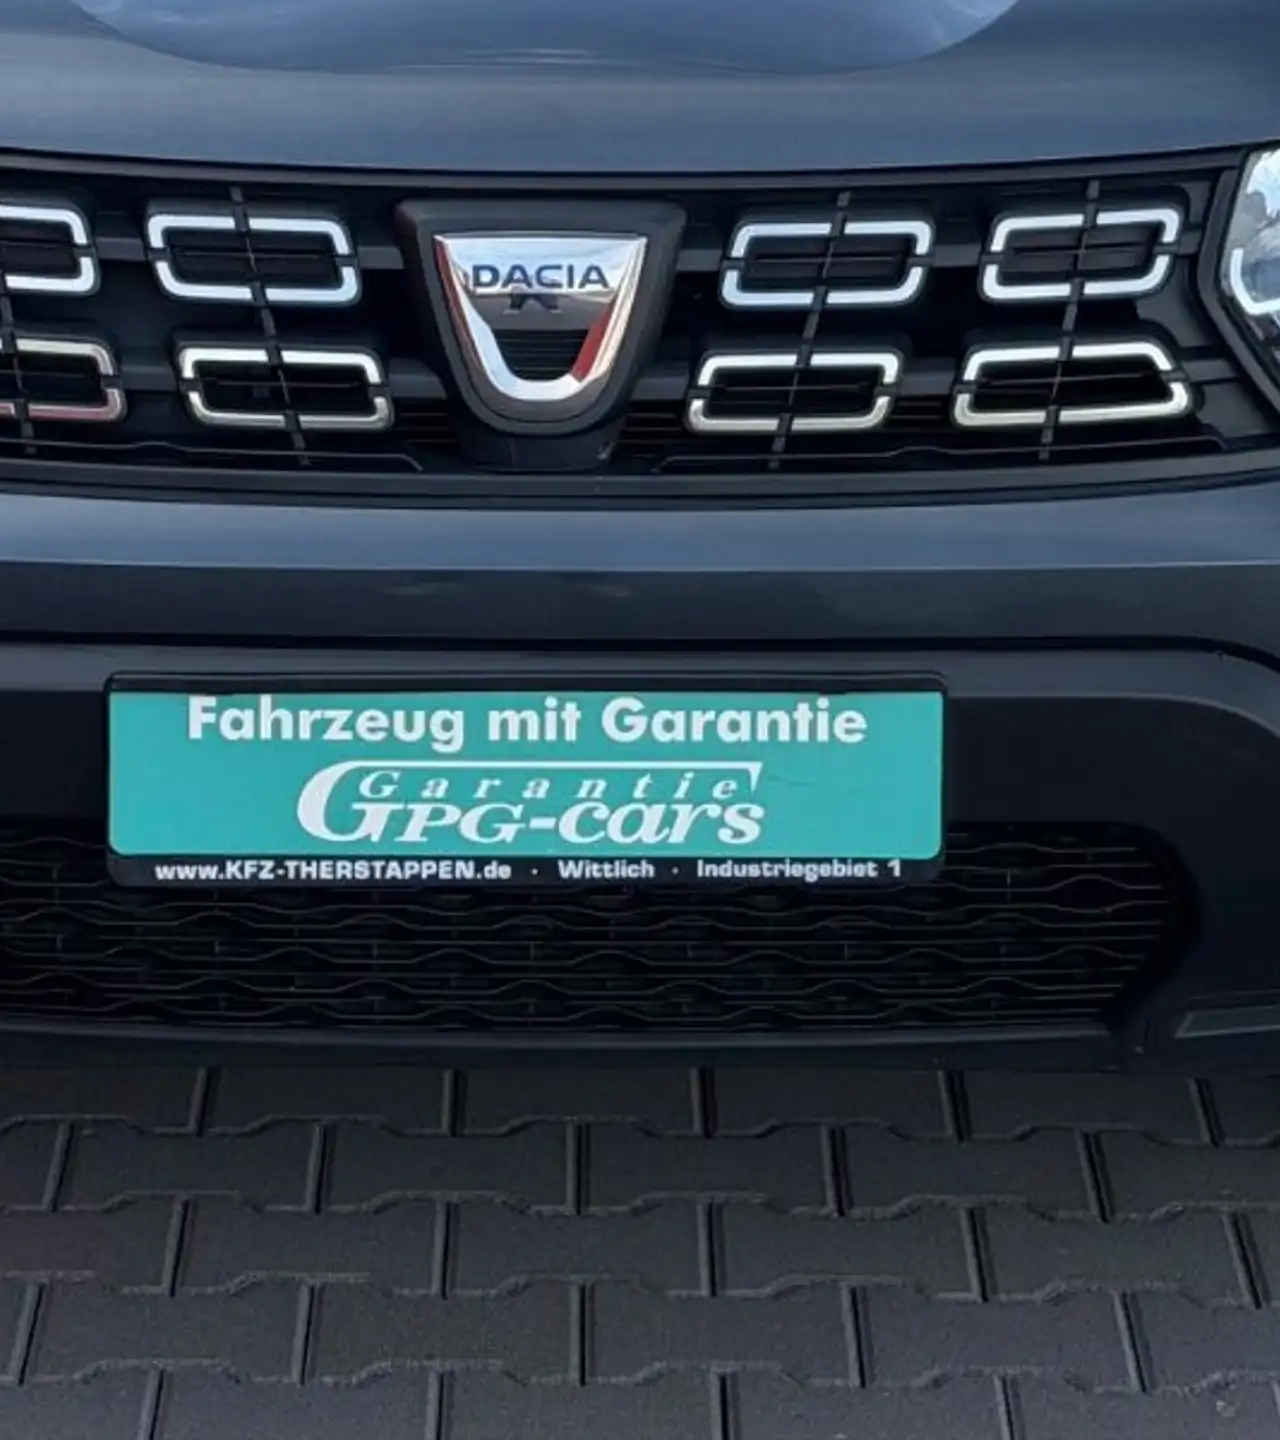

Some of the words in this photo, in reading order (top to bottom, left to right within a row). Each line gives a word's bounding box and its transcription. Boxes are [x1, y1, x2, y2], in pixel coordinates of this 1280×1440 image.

[472, 264, 610, 289] DACIA
[188, 694, 464, 753] Fahrzeug
[487, 696, 582, 742] mit
[601, 696, 867, 743] Garantie
[358, 771, 738, 799] Garantie
[155, 859, 512, 880] www.KFZ-THERSTAPPEN.de
[557, 859, 655, 879] Wittlich
[697, 859, 878, 883] Industriegebiet
[887, 859, 901, 877] 1
